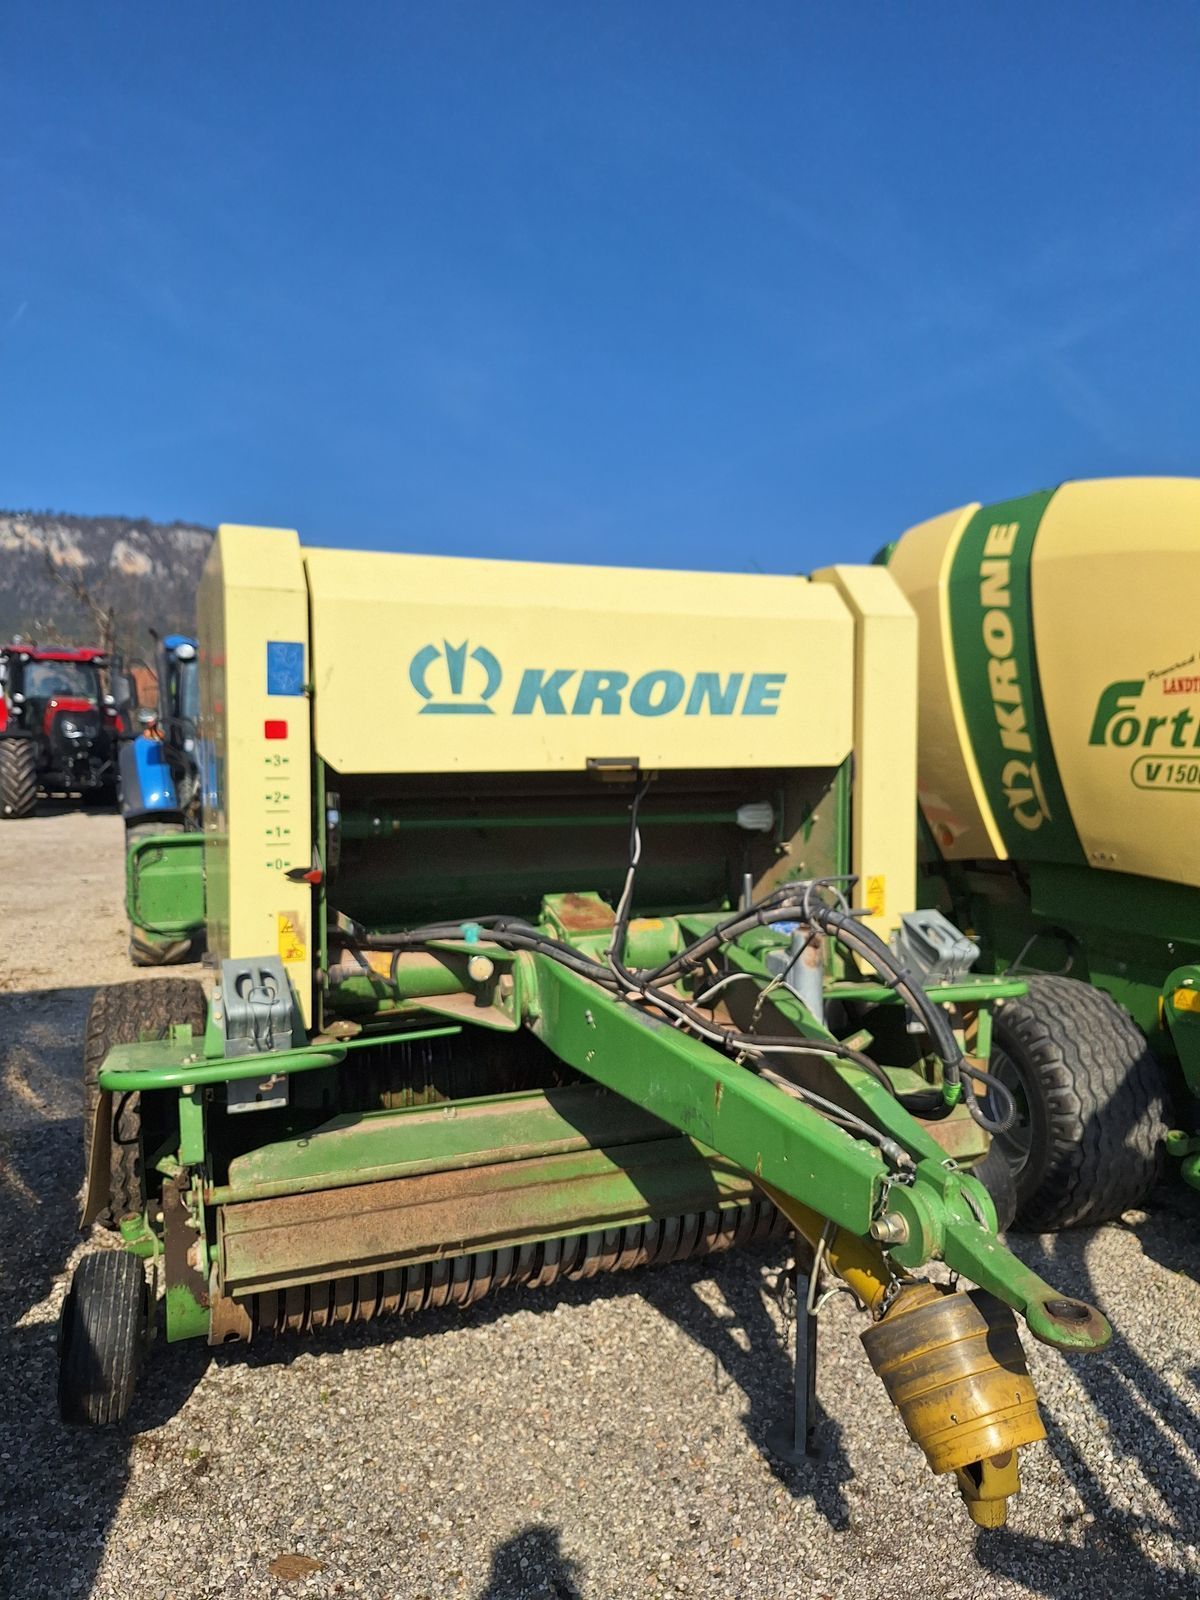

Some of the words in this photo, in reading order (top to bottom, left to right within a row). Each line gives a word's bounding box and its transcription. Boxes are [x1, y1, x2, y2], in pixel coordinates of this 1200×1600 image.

[979, 521, 1032, 753] KRONE
[511, 668, 788, 718] KRONE
[1163, 677, 1200, 695] LANDT
[273, 754, 281, 767] 3
[1145, 763, 1163, 781] V
[1166, 763, 1200, 784] 150
[274, 791, 282, 804] 2
